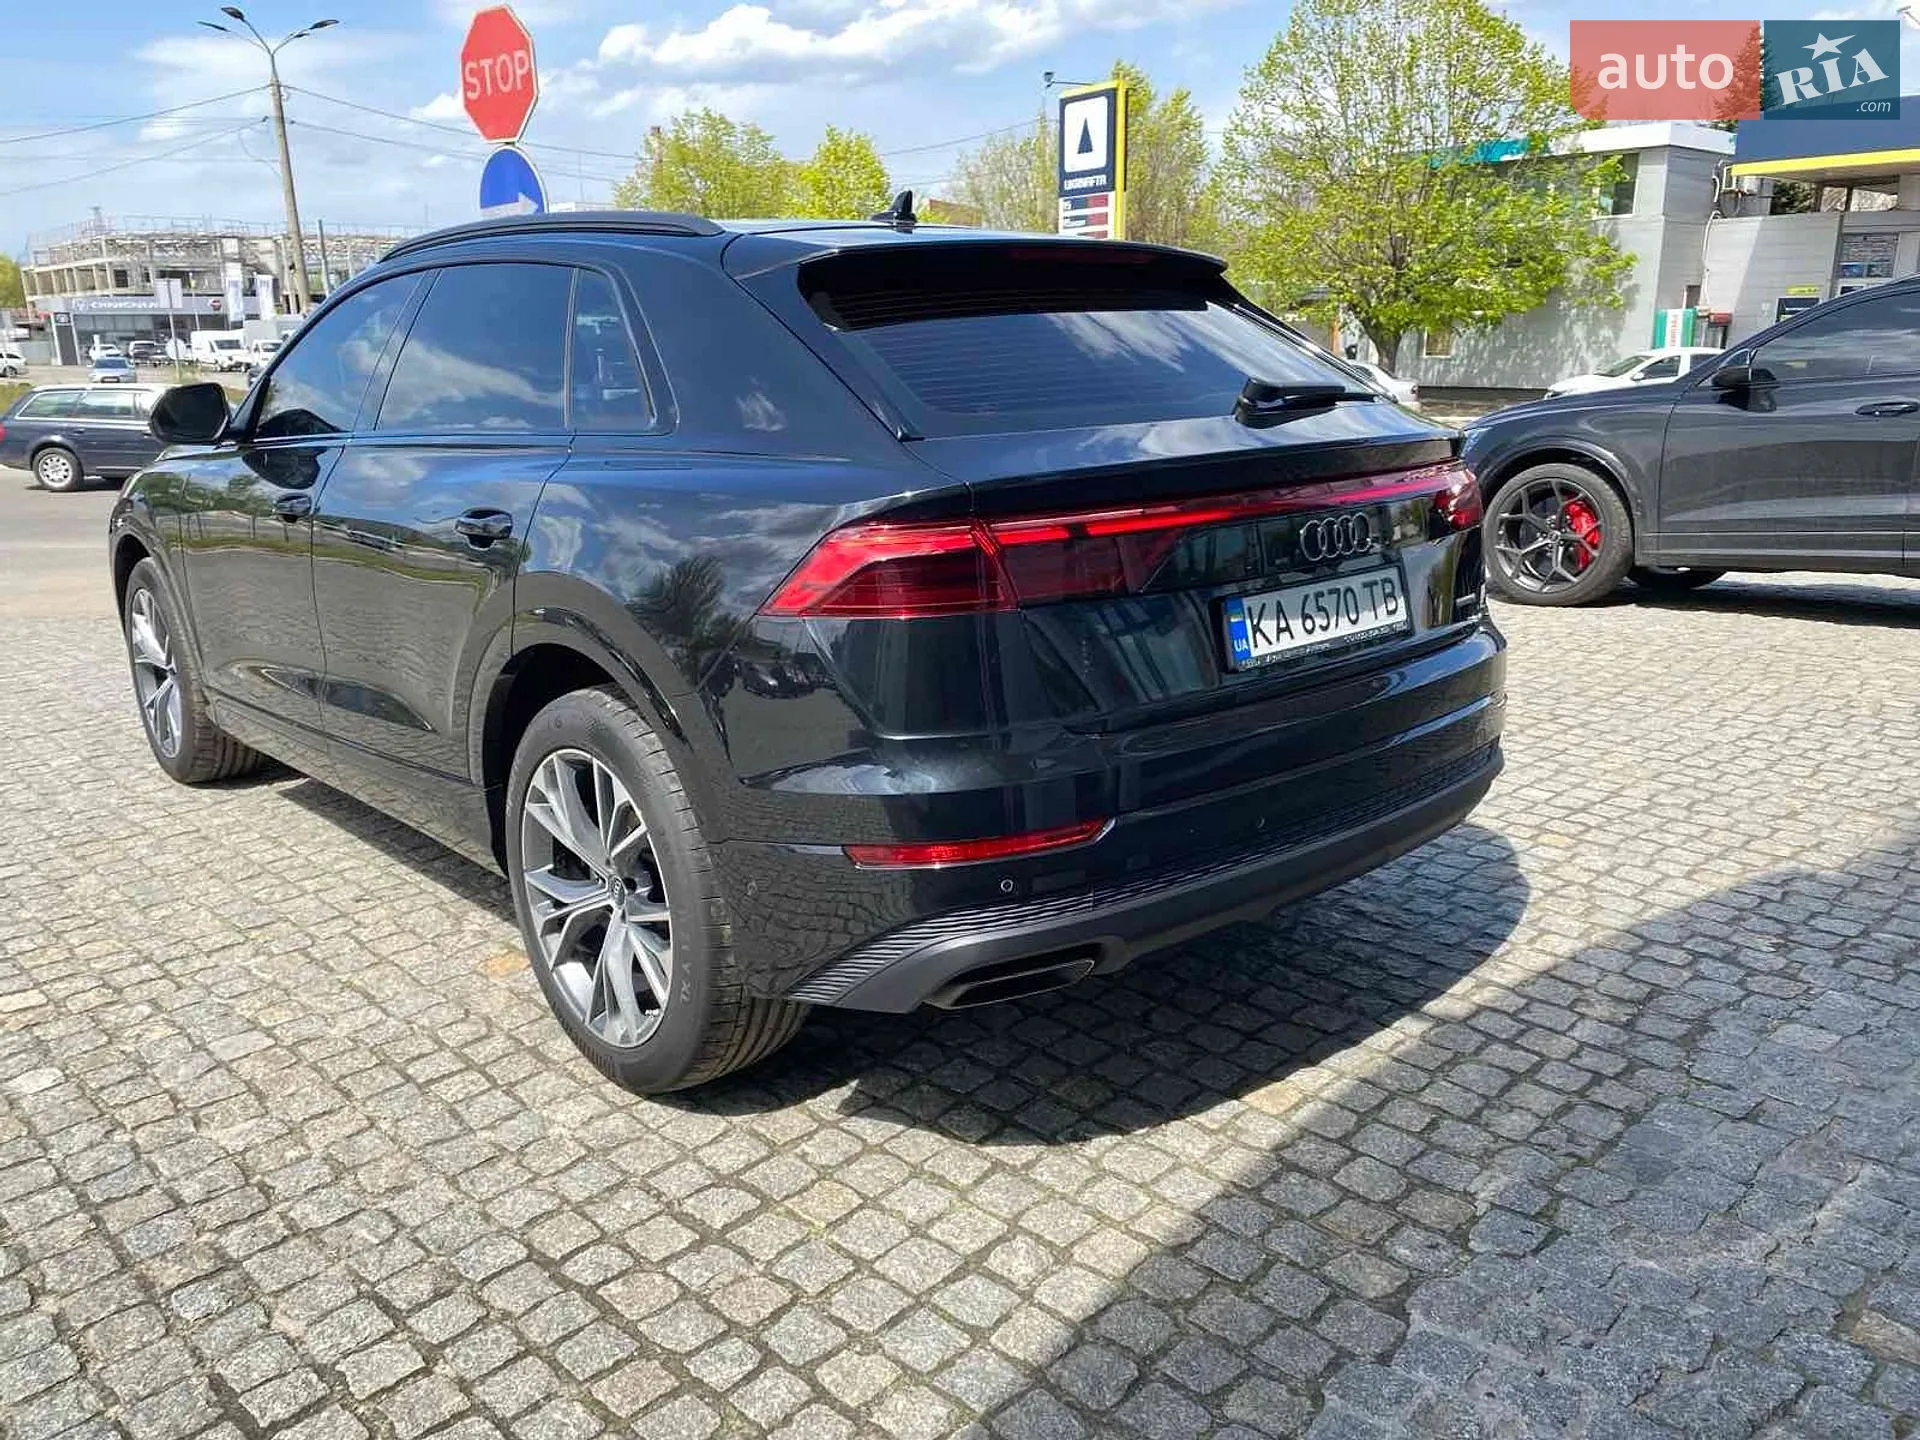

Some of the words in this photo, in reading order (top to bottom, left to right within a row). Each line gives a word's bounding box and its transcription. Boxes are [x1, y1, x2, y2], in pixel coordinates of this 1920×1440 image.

[464, 49, 530, 101] STOP
[1247, 600, 1295, 648] KA
[1301, 587, 1359, 635] 6570
[1362, 577, 1398, 620] TB
[1233, 638, 1249, 652] UA
